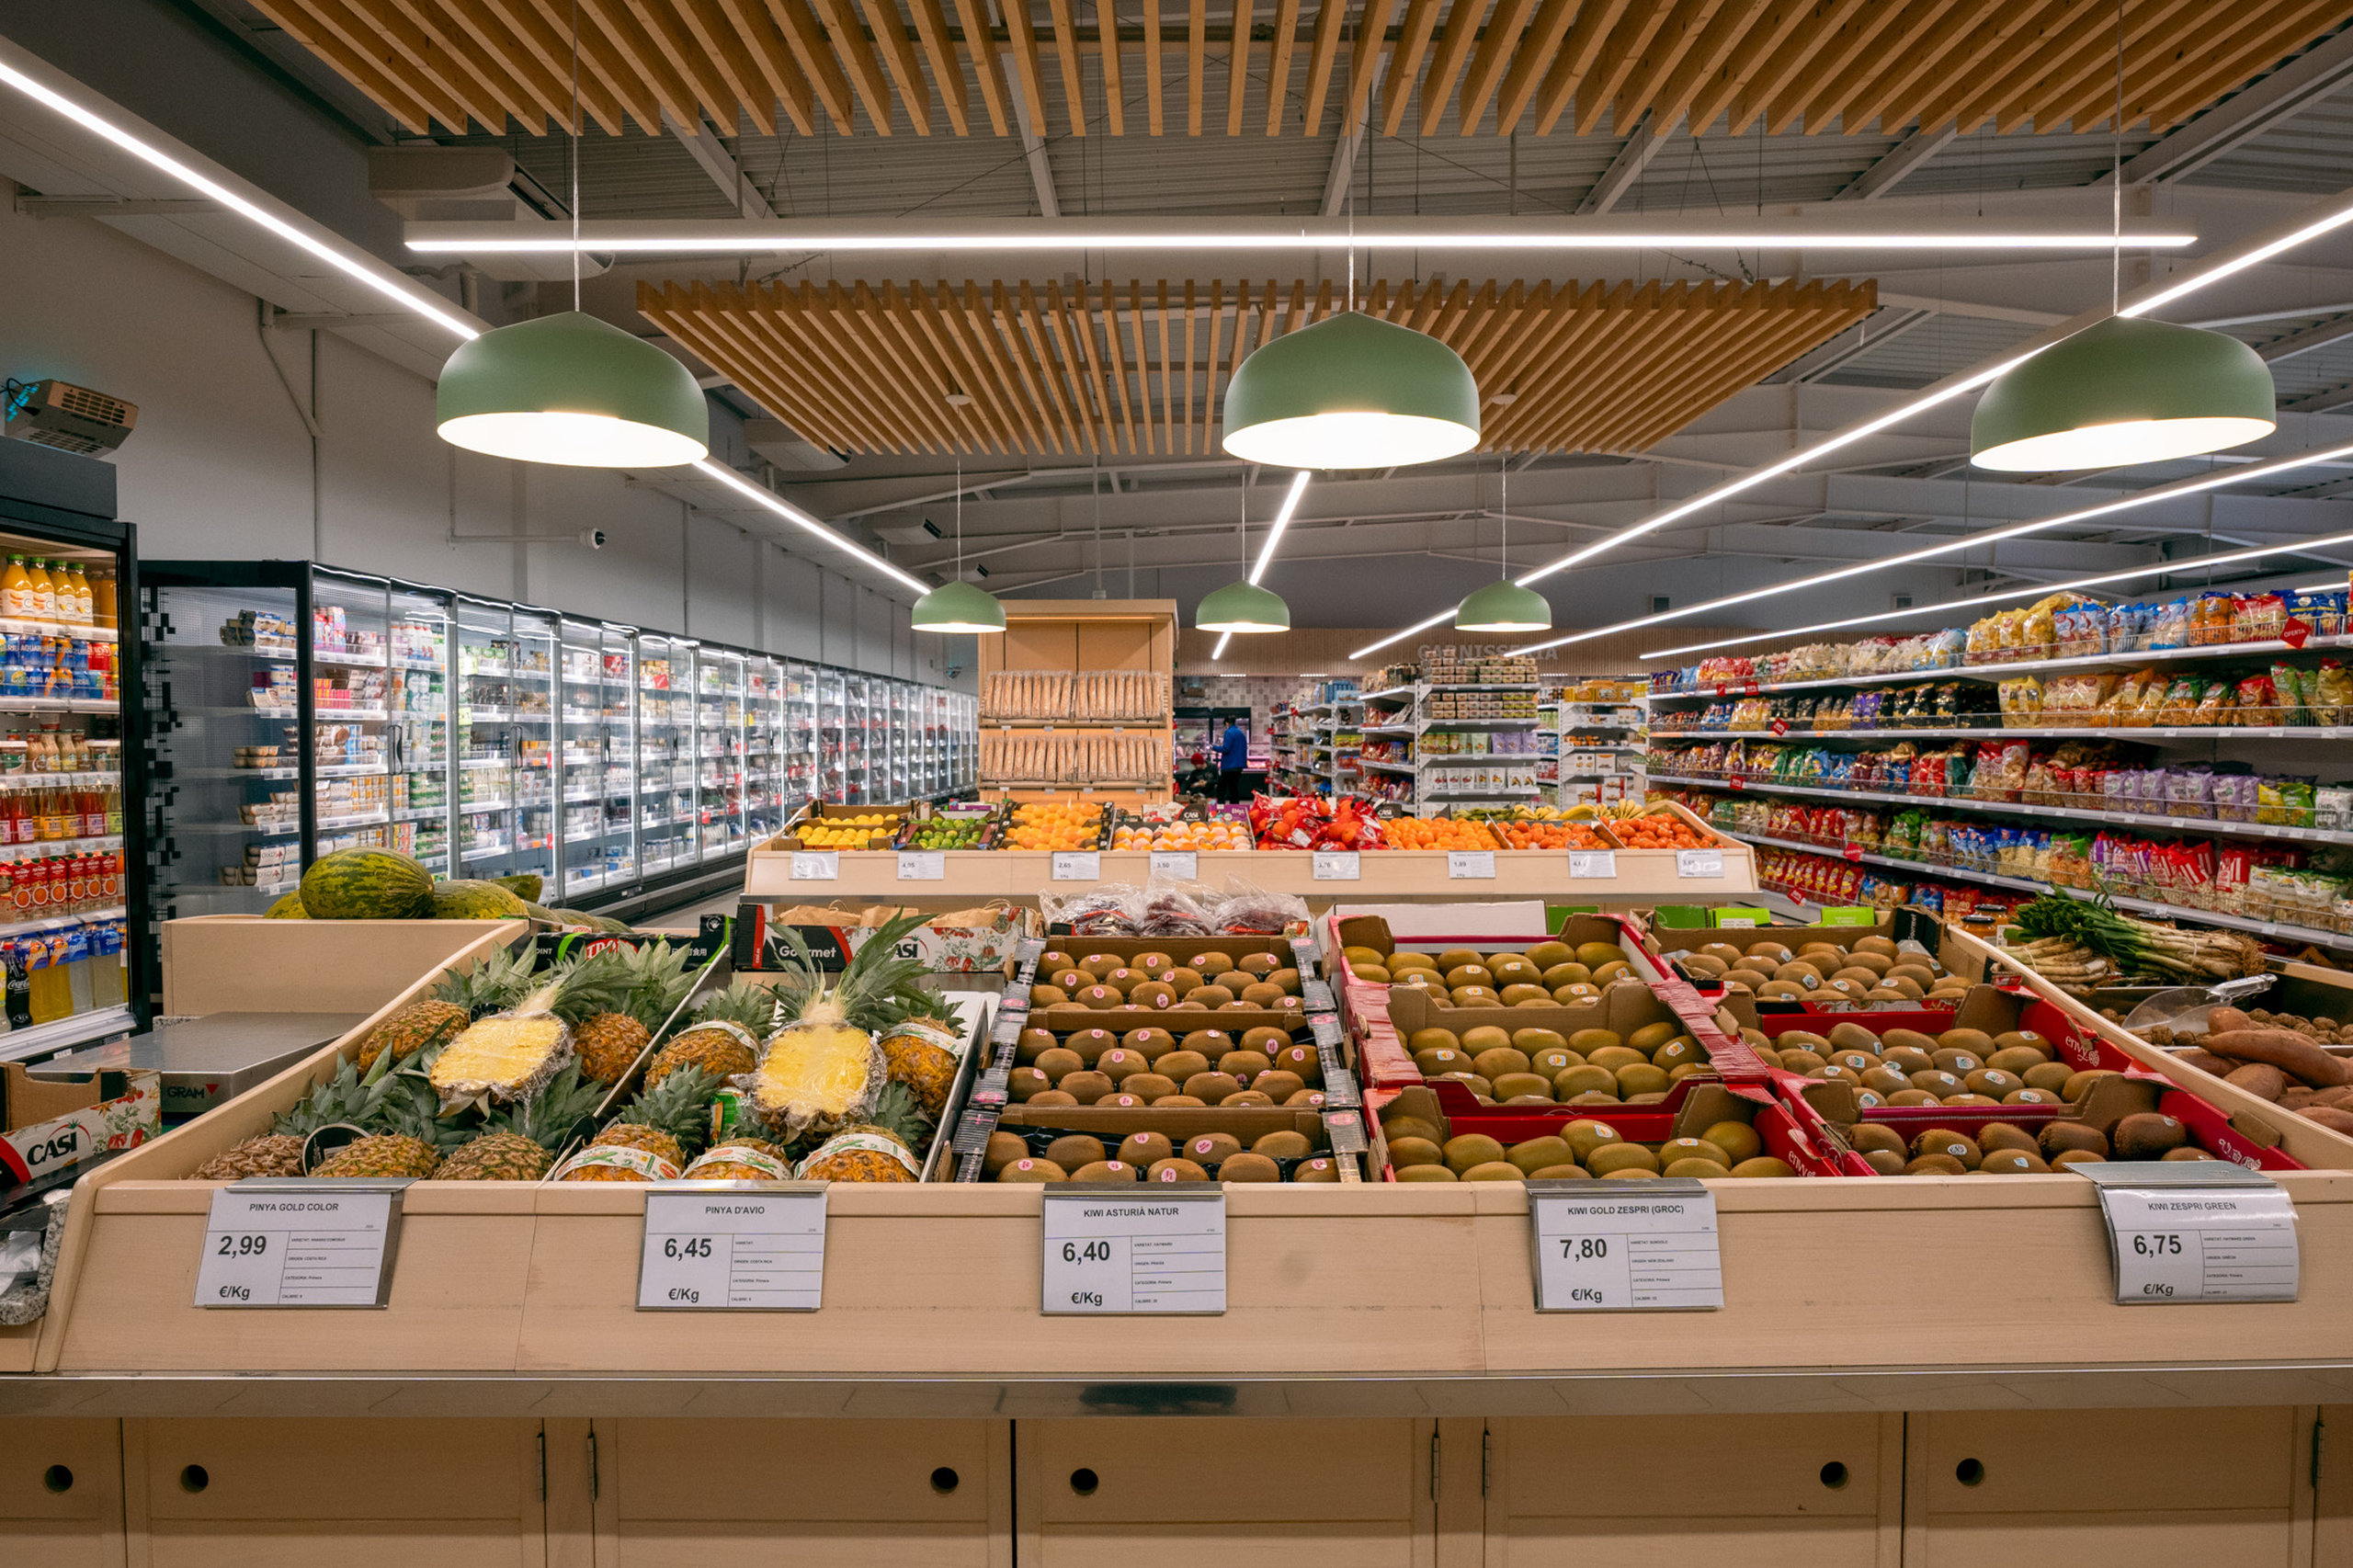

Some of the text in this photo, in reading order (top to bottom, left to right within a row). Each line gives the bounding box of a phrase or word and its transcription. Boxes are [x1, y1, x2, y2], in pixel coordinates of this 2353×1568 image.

[2283, 629, 2306, 637] OFERTA
[779, 946, 838, 959] Gormet
[894, 943, 919, 958] ASI
[167, 1086, 205, 1098] GRAM
[28, 1131, 77, 1165] CASI
[249, 1203, 339, 1211] PINYA GOLD COLOR
[705, 1206, 765, 1214] PINYA D'AVIO
[1084, 1209, 1104, 1218] KIWI
[1147, 1208, 1179, 1216] NATUR
[1567, 1205, 1685, 1215] KIWI GOLD ZESPRI (GROC)
[2147, 1202, 2237, 1210] KIWI ZESPRI GREEN
[218, 1235, 267, 1259] 2,99
[665, 1238, 712, 1261] 6,45
[1063, 1241, 1110, 1265] 6,40
[1560, 1238, 1608, 1262] 7,80
[2133, 1234, 2182, 1258] 6,75
[219, 1286, 251, 1301] €/Kg
[668, 1288, 699, 1303] €/Kg
[1571, 1288, 1602, 1303] €/Kg
[2143, 1283, 2174, 1297] €/Kg
[1071, 1291, 1103, 1306] €/Kg
